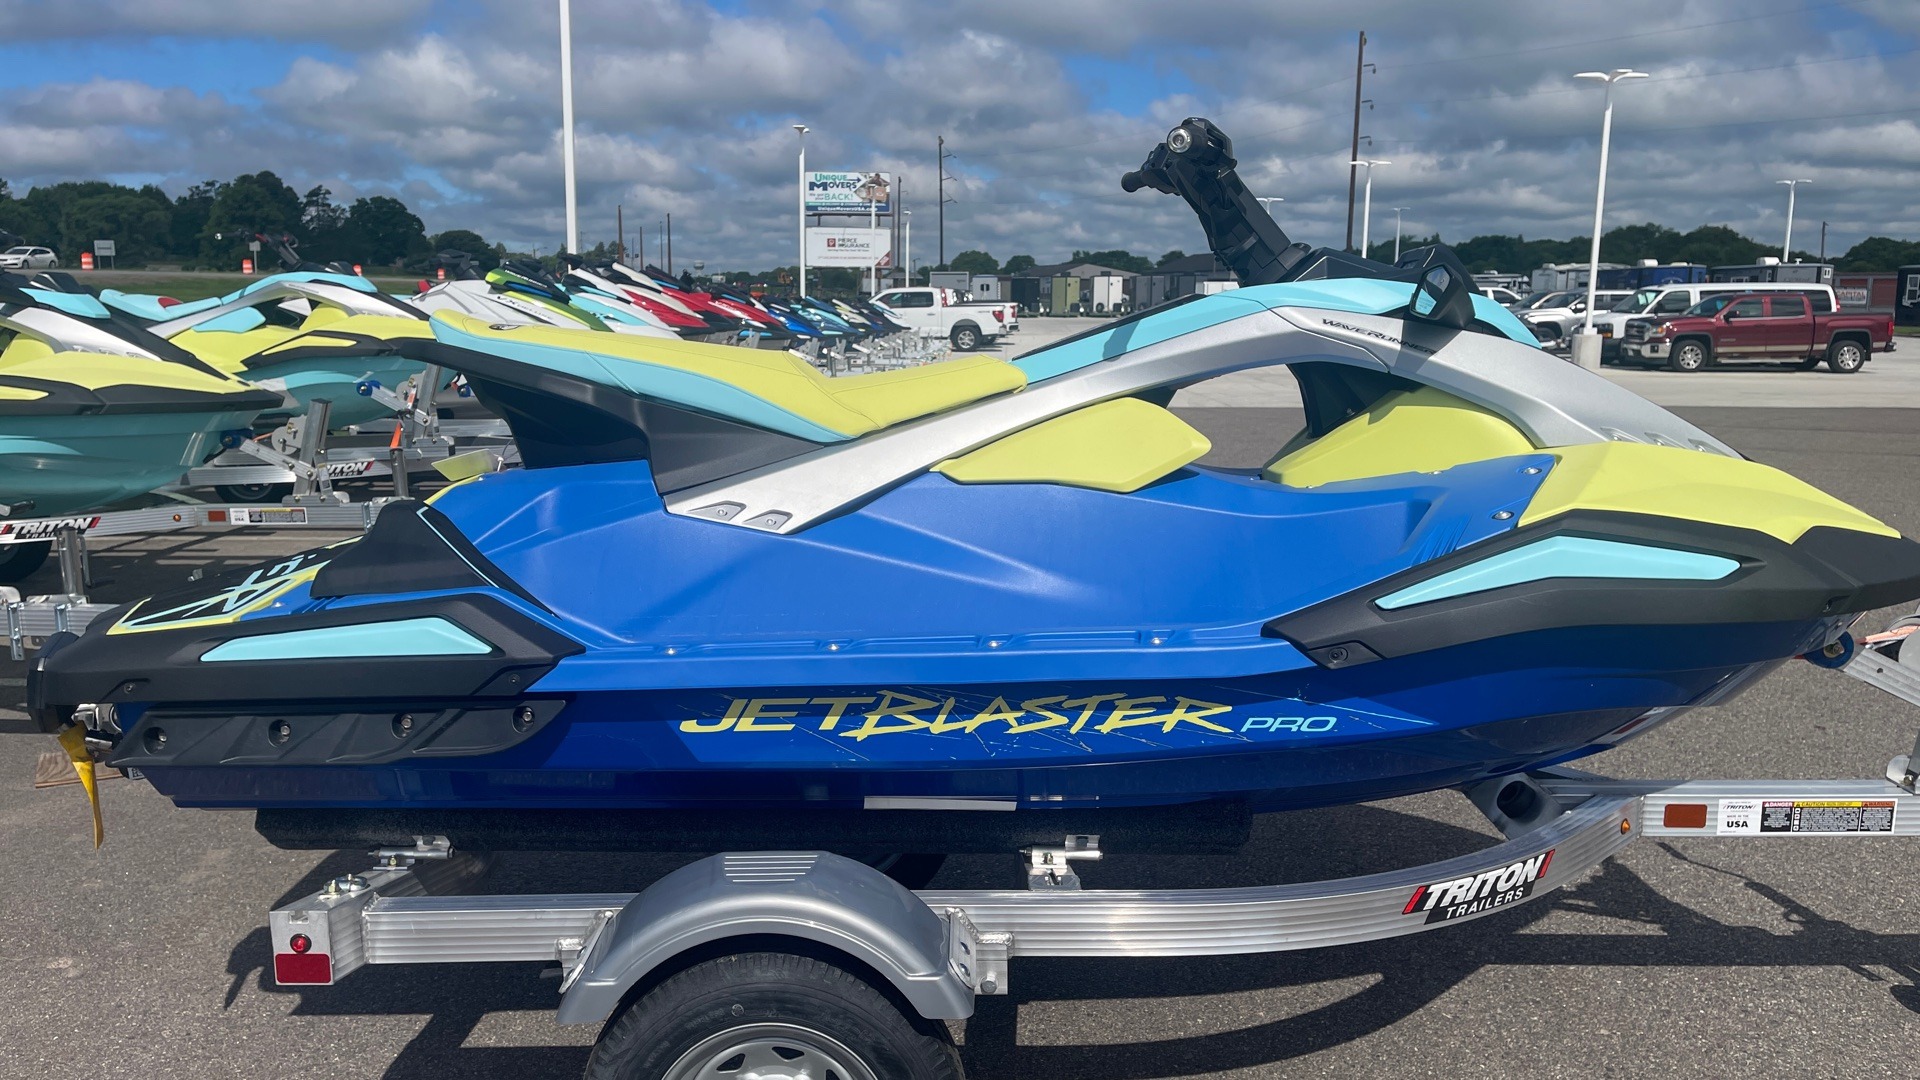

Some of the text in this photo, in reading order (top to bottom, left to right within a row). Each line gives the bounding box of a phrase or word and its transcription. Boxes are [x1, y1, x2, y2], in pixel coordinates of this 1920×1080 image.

[809, 181, 857, 191] MOVERS
[824, 193, 854, 201] BACK!
[1323, 319, 1438, 355] WAVERUNNER
[10, 517, 92, 535] TRITON
[679, 689, 1338, 741] JETBLASTER PRO
[1727, 820, 1749, 828] USA
[1423, 853, 1546, 910] TRITON
[1446, 887, 1524, 920] TRAILERS
